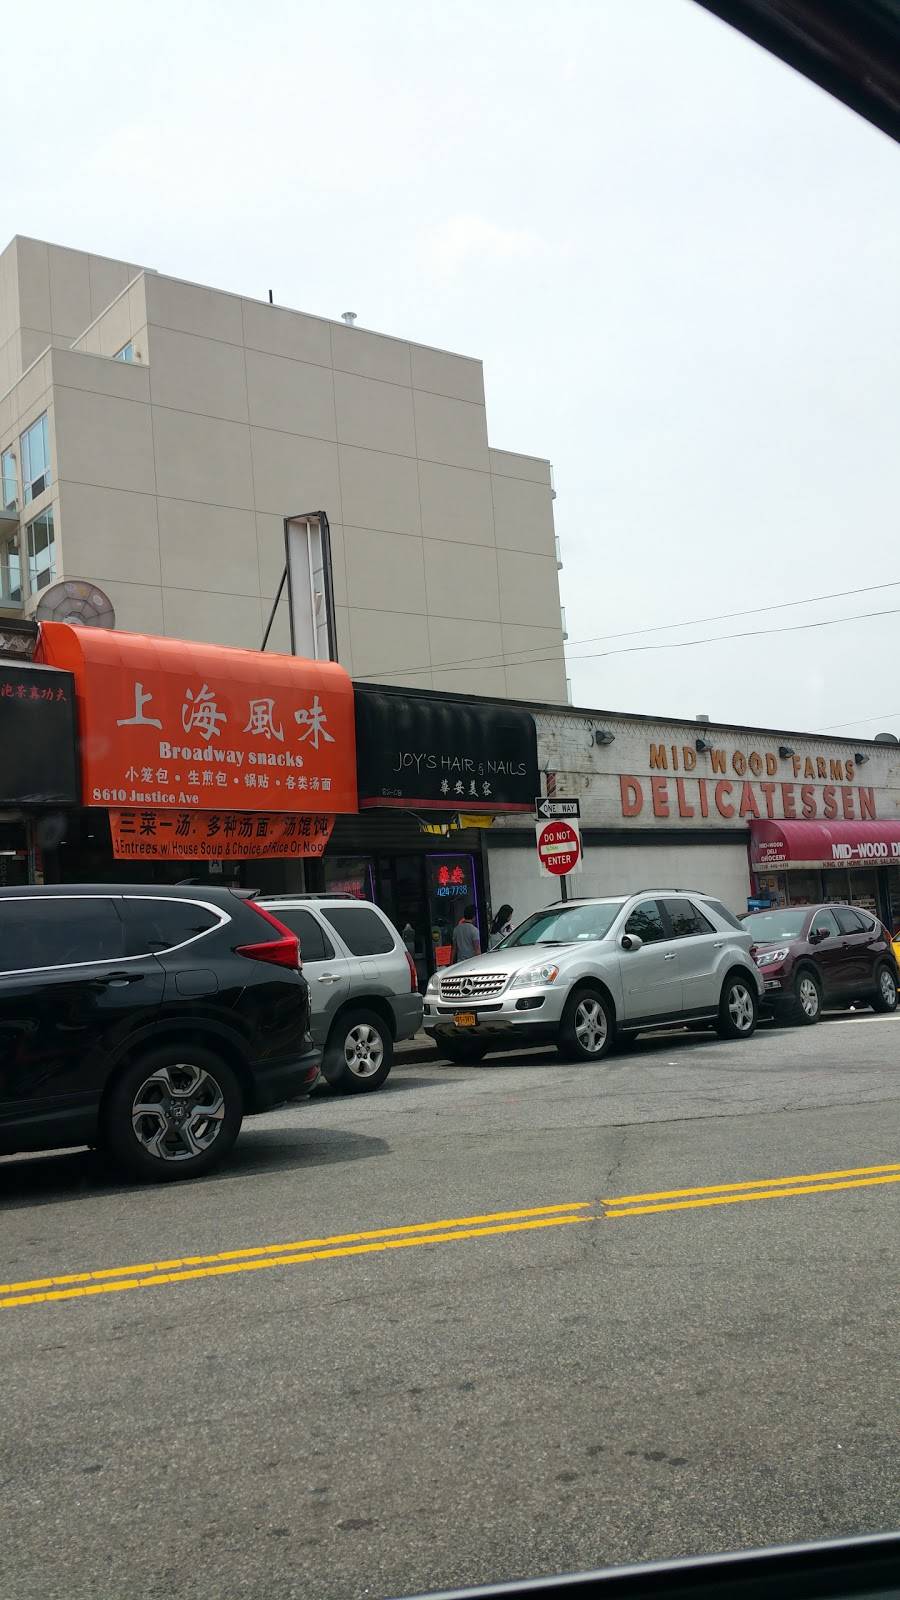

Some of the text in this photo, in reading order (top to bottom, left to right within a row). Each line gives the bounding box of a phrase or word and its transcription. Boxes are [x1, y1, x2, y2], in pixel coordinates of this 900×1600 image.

[117, 682, 336, 750] 上海風味
[159, 741, 304, 768] Broadway snacks
[649, 743, 856, 781] MID WOOD FARMS
[393, 752, 437, 775] JOY'S
[441, 755, 476, 772] HAIR
[488, 760, 527, 776] NAILS
[125, 766, 331, 791] 小笼包 生煎包 锅贴 各类汤面
[93, 788, 199, 804] 8610 Justice Ave
[619, 773, 878, 821] DELICATESSEN
[544, 804, 575, 813] ONE WAY
[544, 831, 571, 842] DO NOT
[172, 840, 198, 855] House
[200, 841, 222, 857] Soup
[232, 842, 261, 856] Choice
[290, 840, 301, 854] Or
[831, 842, 889, 860] MID-WOOD
[548, 855, 571, 866] ENTER
[760, 854, 786, 862] GROCERY
